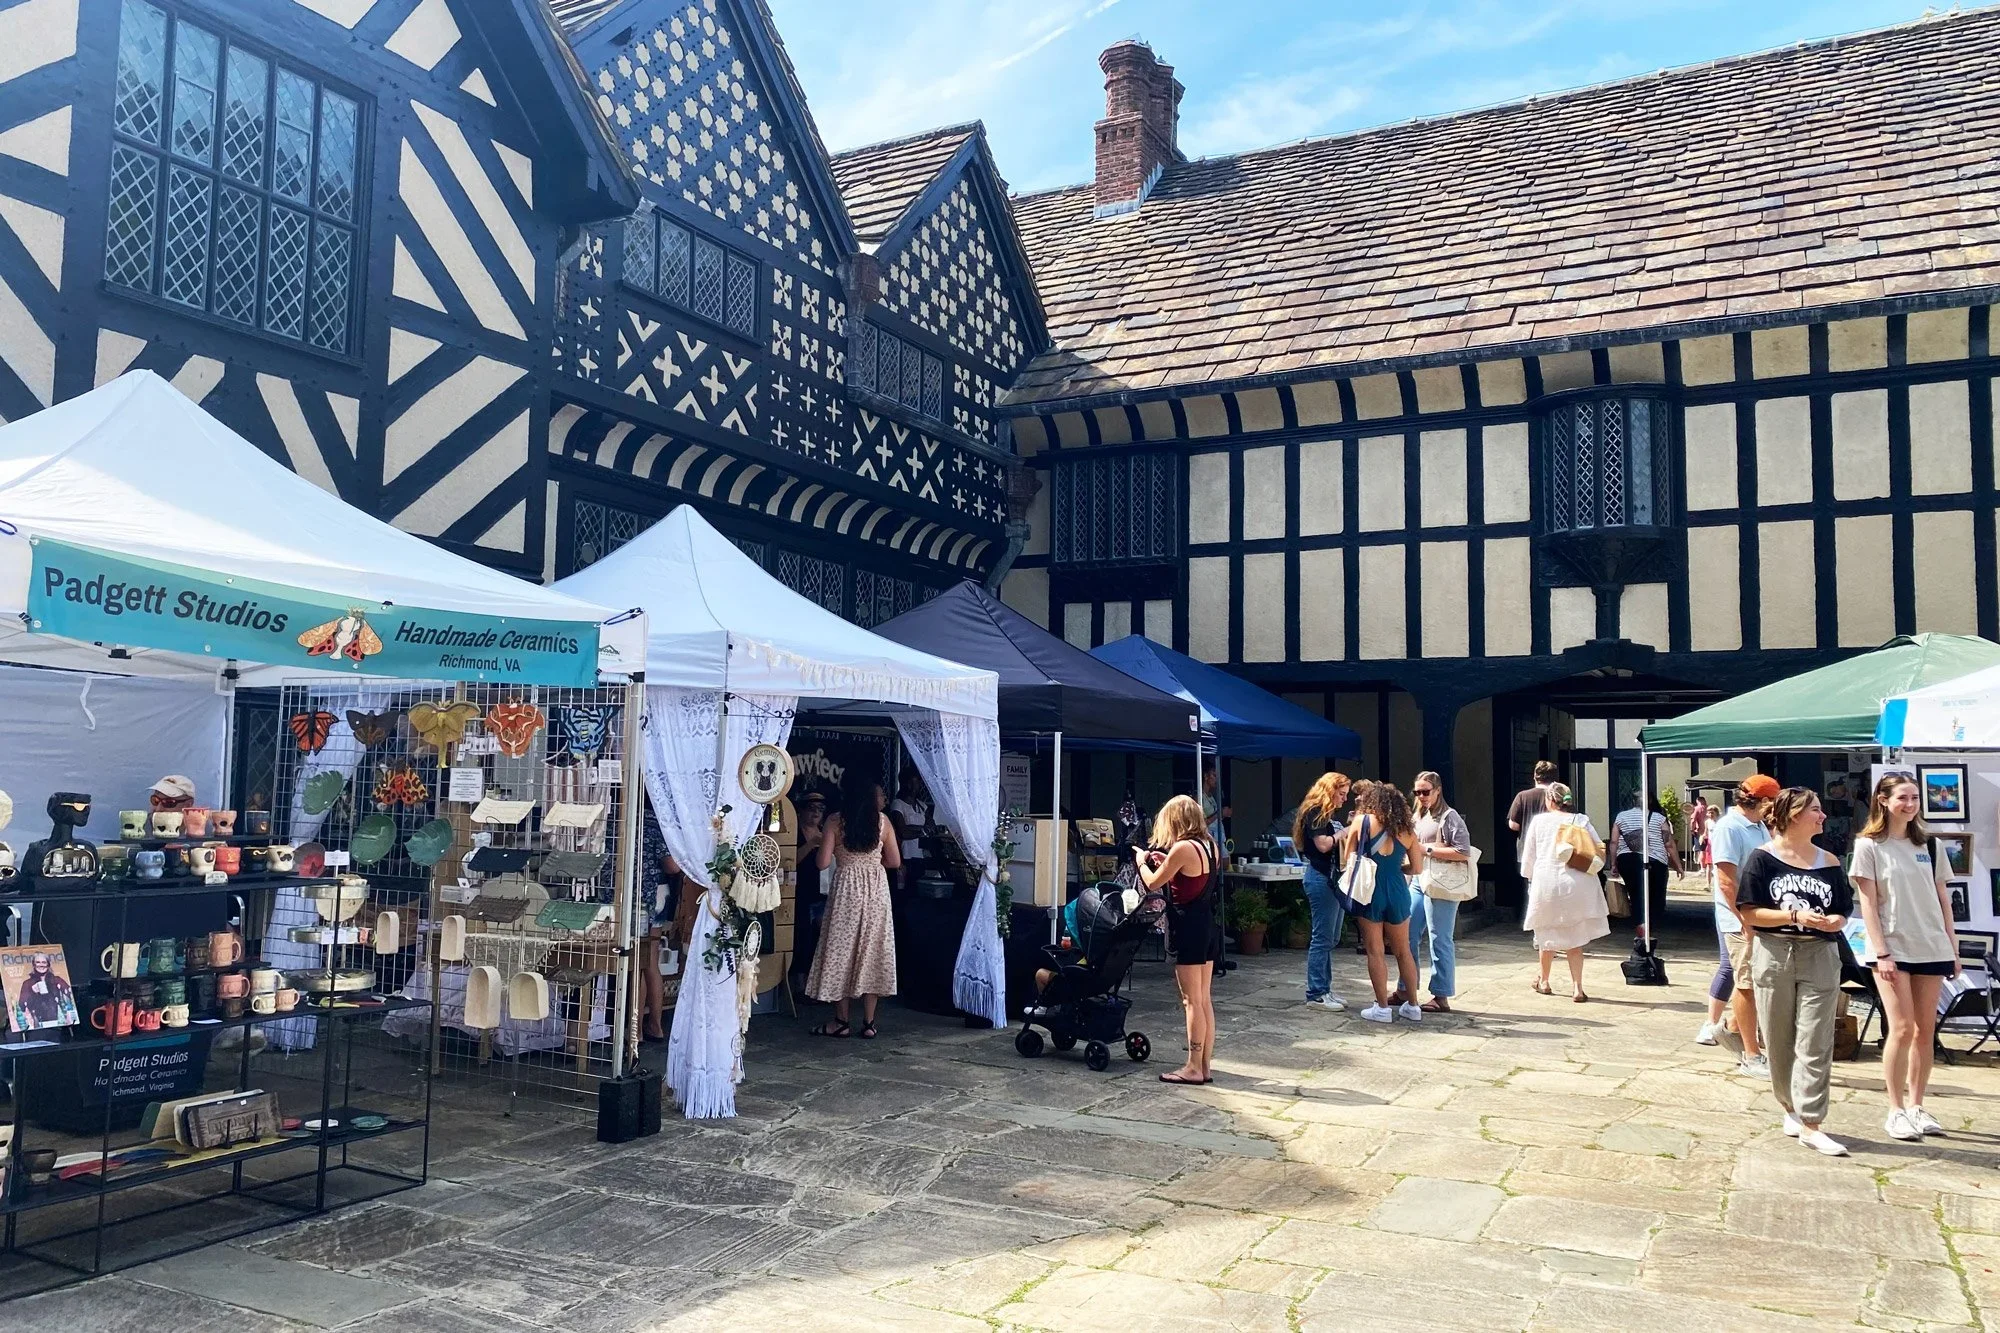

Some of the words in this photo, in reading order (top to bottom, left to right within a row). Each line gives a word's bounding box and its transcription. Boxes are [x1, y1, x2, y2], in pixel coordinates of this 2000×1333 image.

[44, 566, 167, 616] Padgett
[173, 590, 289, 634] Studios
[394, 620, 497, 649] Handmade
[500, 630, 579, 655] Ceramics
[439, 654, 501, 673] Richmond,
[504, 658, 521, 673] VA
[754, 748, 780, 759] Gemini
[1006, 765, 1028, 774] FAMILY
[2, 953, 64, 966] Richmnd
[150, 1051, 189, 1067] Studios
[94, 1072, 147, 1086] Hadmade
[112, 1084, 147, 1097] ichmond,
[149, 1081, 175, 1093] Virginia
